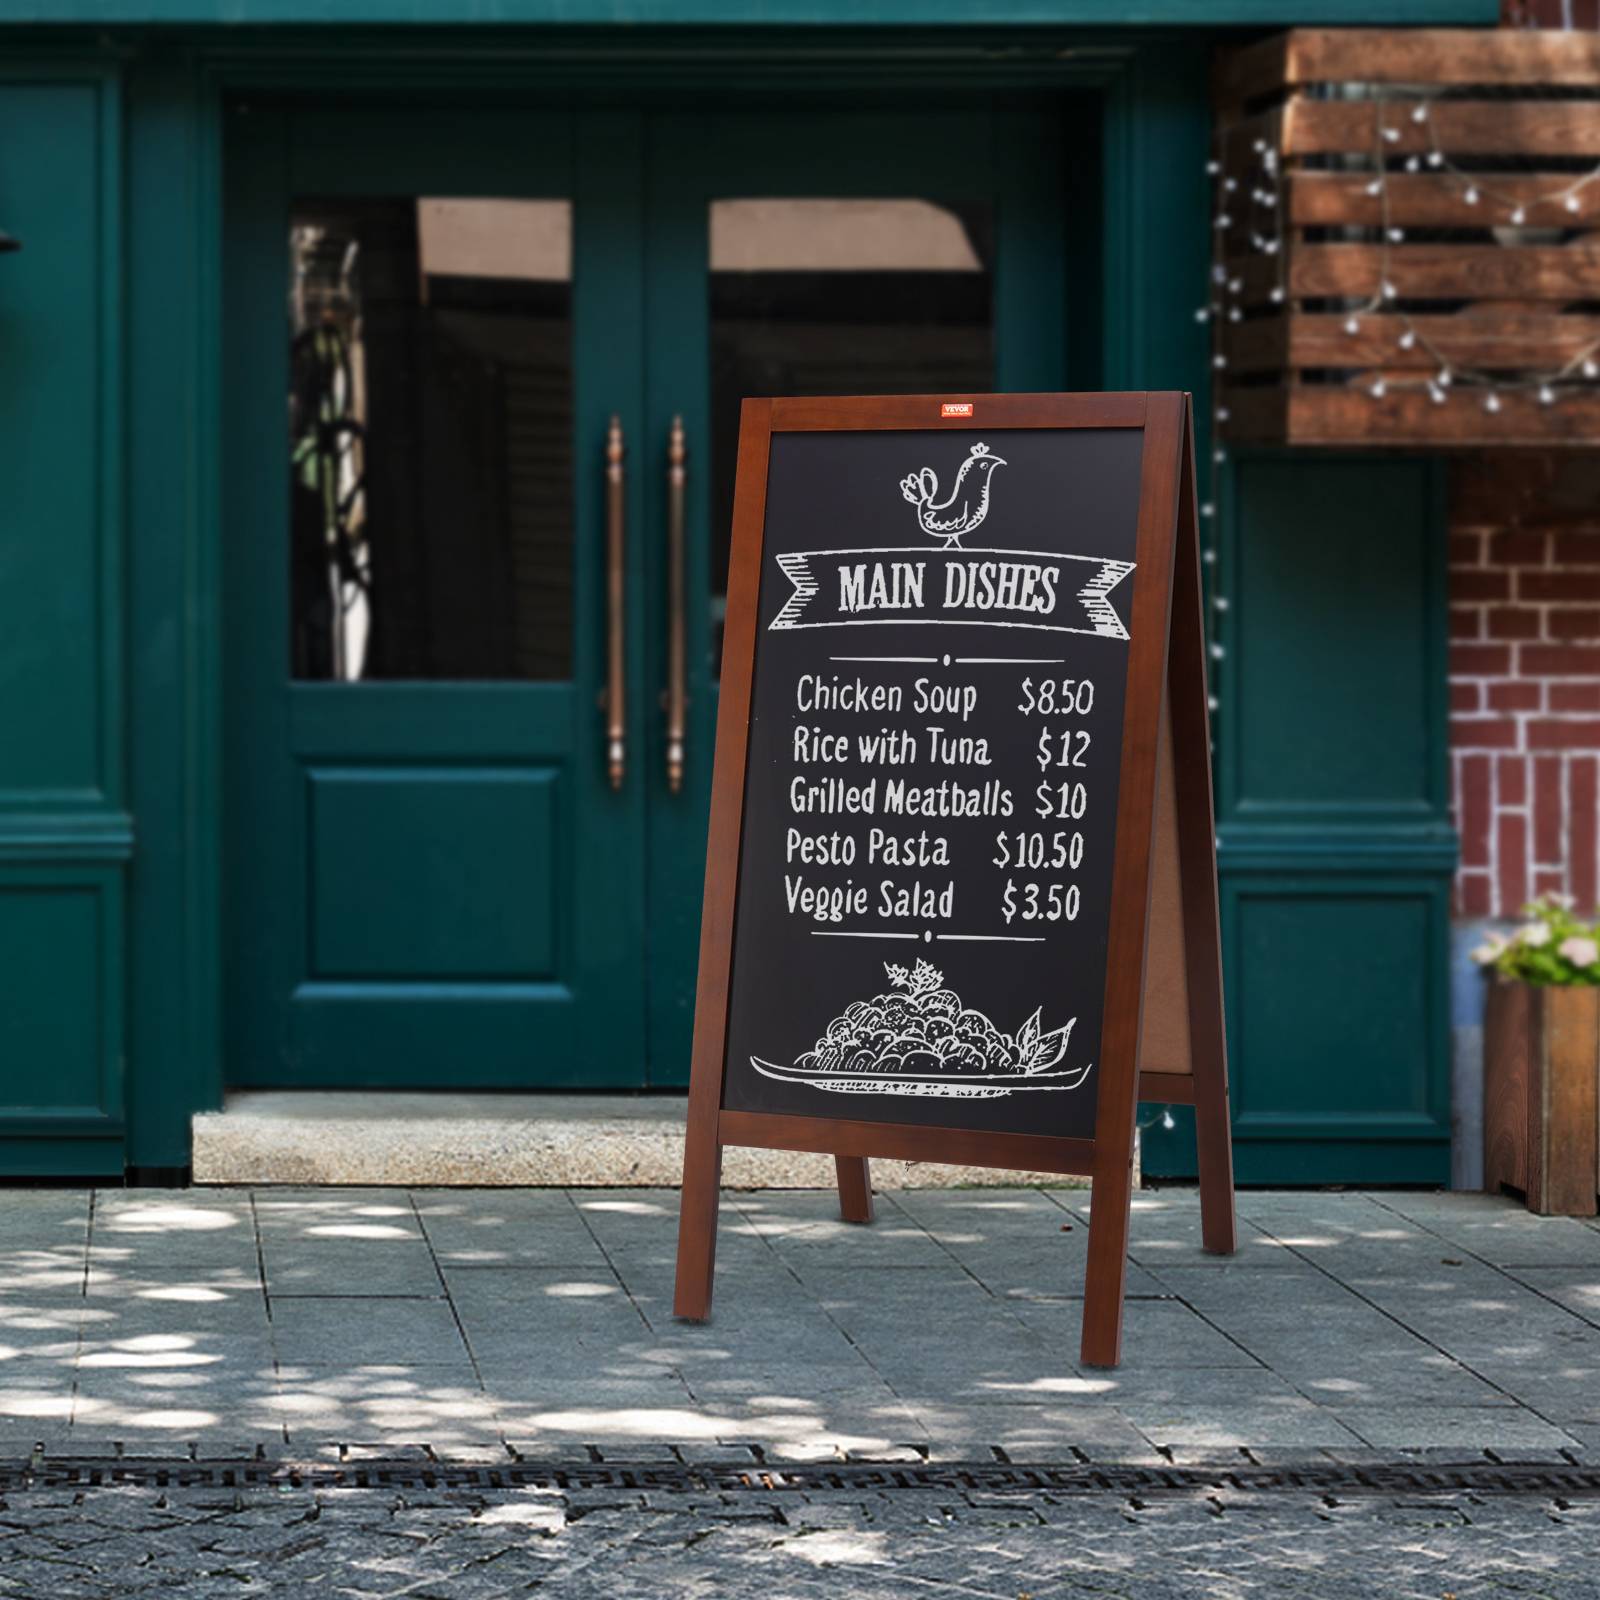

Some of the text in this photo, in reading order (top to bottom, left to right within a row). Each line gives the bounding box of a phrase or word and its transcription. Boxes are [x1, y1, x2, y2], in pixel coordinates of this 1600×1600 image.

[838, 562, 1060, 614] MAIN DISHES
[797, 675, 1094, 721] Chicken Soup $8.50
[794, 726, 1090, 772] Rice with Tuna $12
[791, 776, 1087, 819] Grilled Meatballs $10
[787, 828, 1083, 869] Pesto Pasta $10.50
[785, 875, 1080, 924] Veggie Salad $3.50
